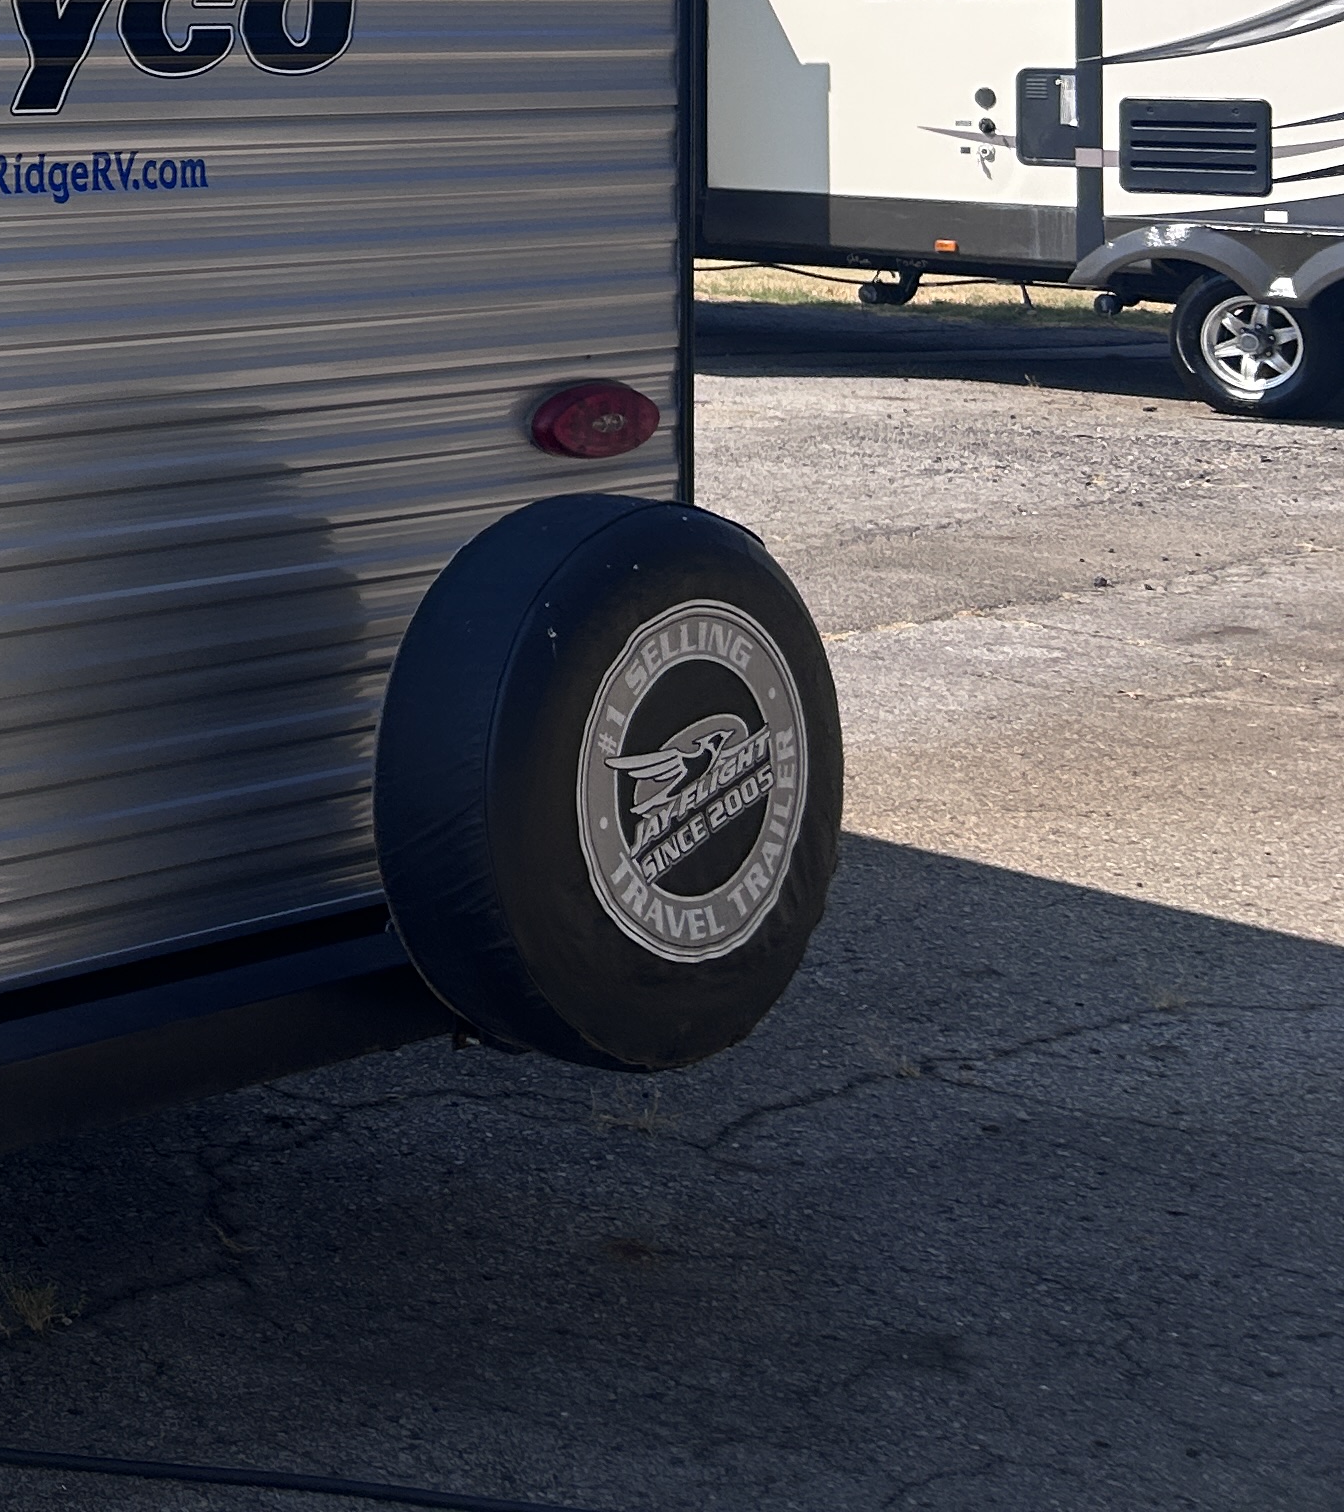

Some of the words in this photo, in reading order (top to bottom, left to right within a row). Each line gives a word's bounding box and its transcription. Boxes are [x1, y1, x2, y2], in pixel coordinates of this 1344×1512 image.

[596, 703, 628, 756] #1
[624, 621, 754, 696] SELLING
[610, 851, 726, 940] TRAVEL
[727, 726, 794, 917] TRAILER
[631, 800, 681, 859] JAY
[678, 728, 772, 818] FLIGHT
[641, 814, 709, 884] SINCE
[708, 765, 776, 828] 2005
